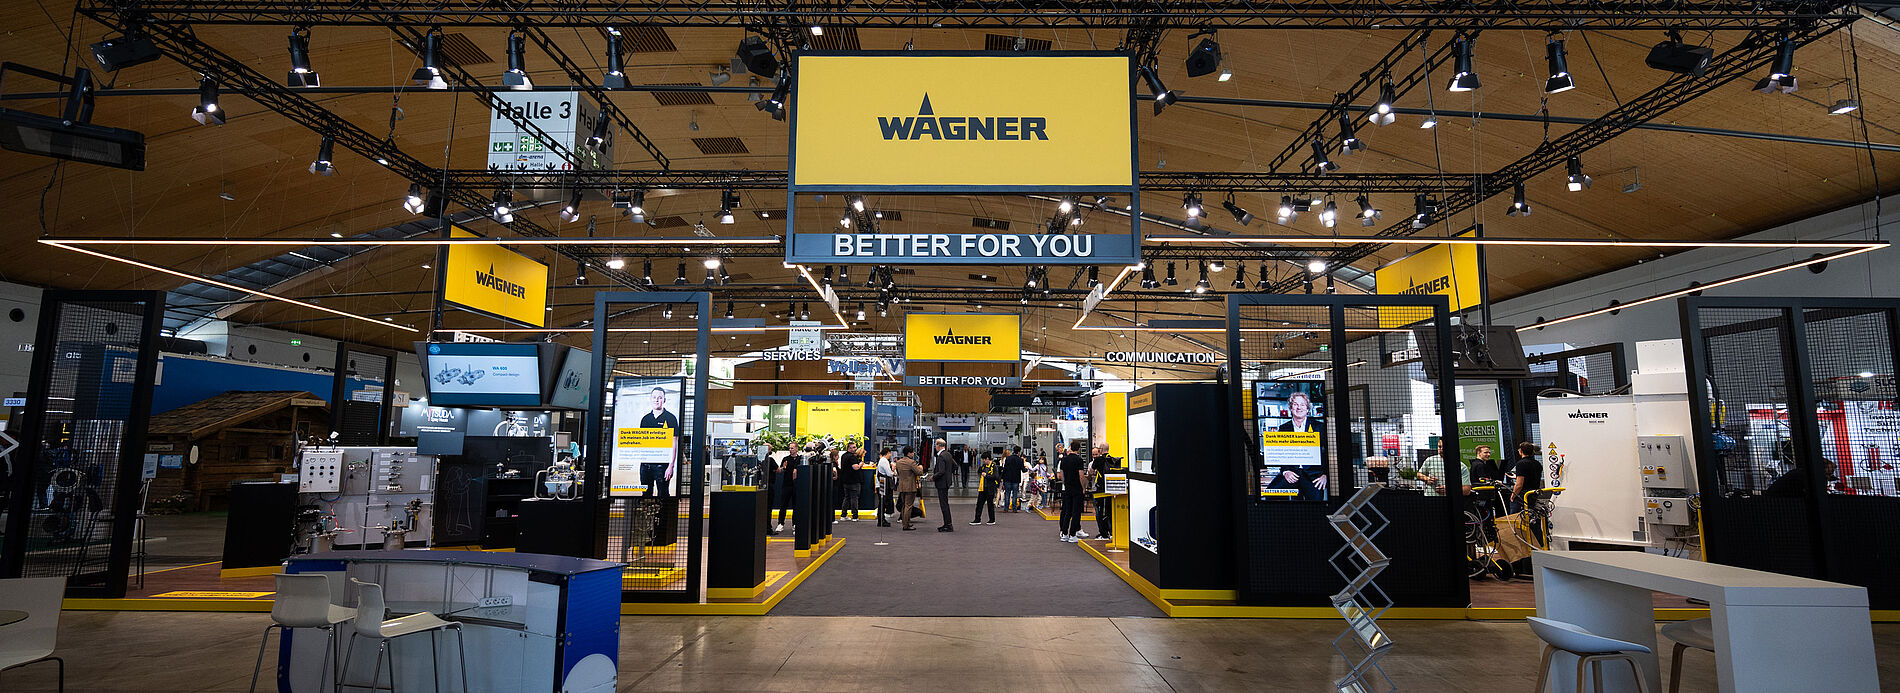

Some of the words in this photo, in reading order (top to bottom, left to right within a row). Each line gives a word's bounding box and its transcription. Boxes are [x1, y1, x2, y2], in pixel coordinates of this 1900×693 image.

[497, 102, 552, 119] Halle
[559, 101, 571, 119] 3
[877, 91, 1049, 140] WAGNER
[834, 235, 951, 257] BETTER
[960, 235, 1021, 257] FOR
[1028, 235, 1092, 257] YOU
[476, 262, 525, 299] WAGNER
[934, 328, 991, 344] WAGNER
[763, 352, 821, 360] SERVICES
[1106, 352, 1215, 363] COMMUNICATION
[919, 377, 958, 385] BETTER
[961, 377, 981, 385] FOR
[984, 377, 1006, 385] YOU
[1568, 409, 1608, 418] WAGNER
